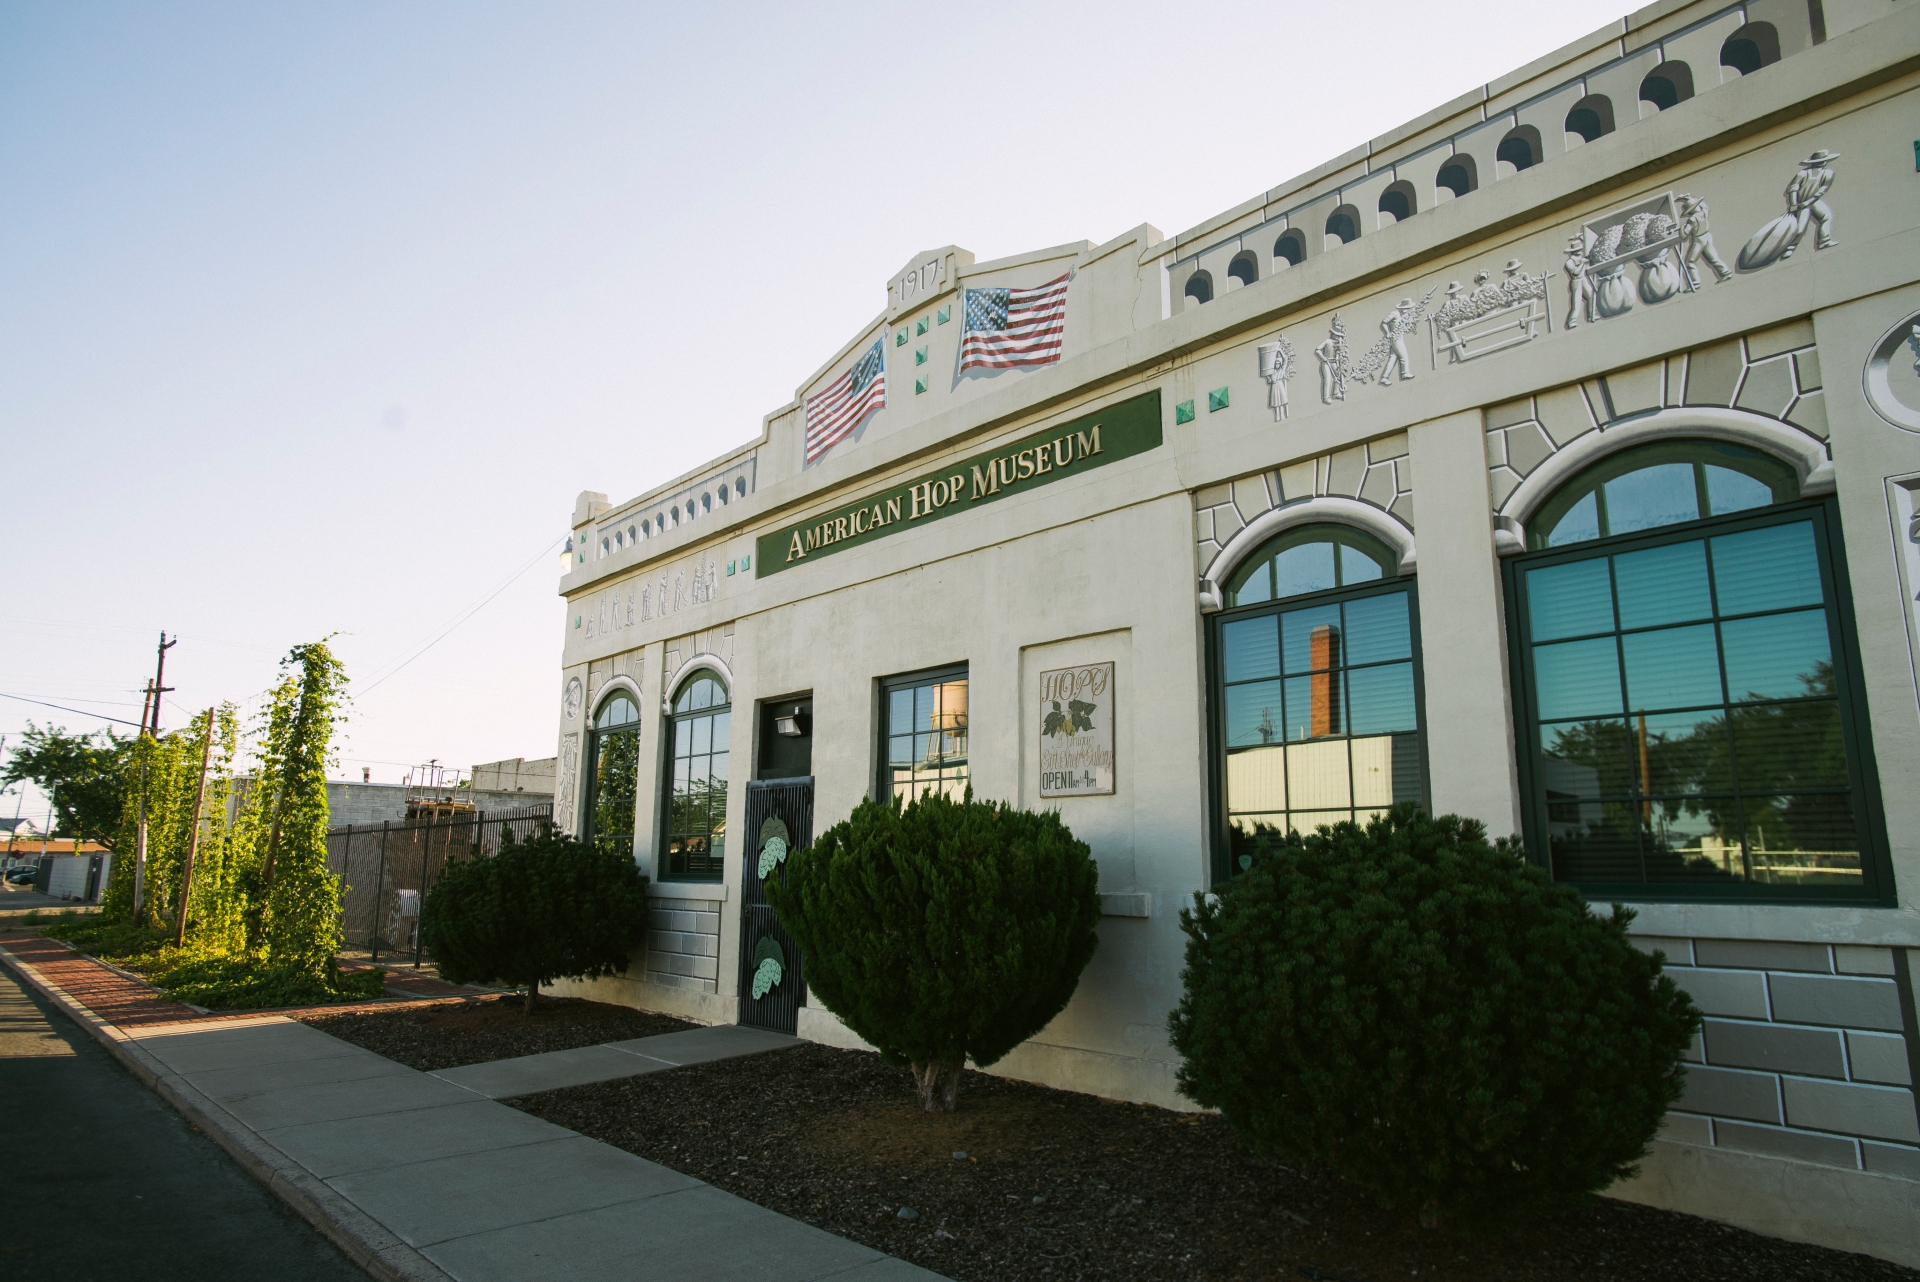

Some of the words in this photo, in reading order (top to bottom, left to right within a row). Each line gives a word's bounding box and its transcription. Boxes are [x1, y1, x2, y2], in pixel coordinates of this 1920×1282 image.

[900, 258, 939, 301] 1917
[786, 496, 903, 562] AMERICAN
[908, 474, 966, 520] HOP
[970, 424, 1105, 501] MUSEUM
[1042, 666, 1111, 702] HOPS
[1042, 771, 1067, 790] OPEN
